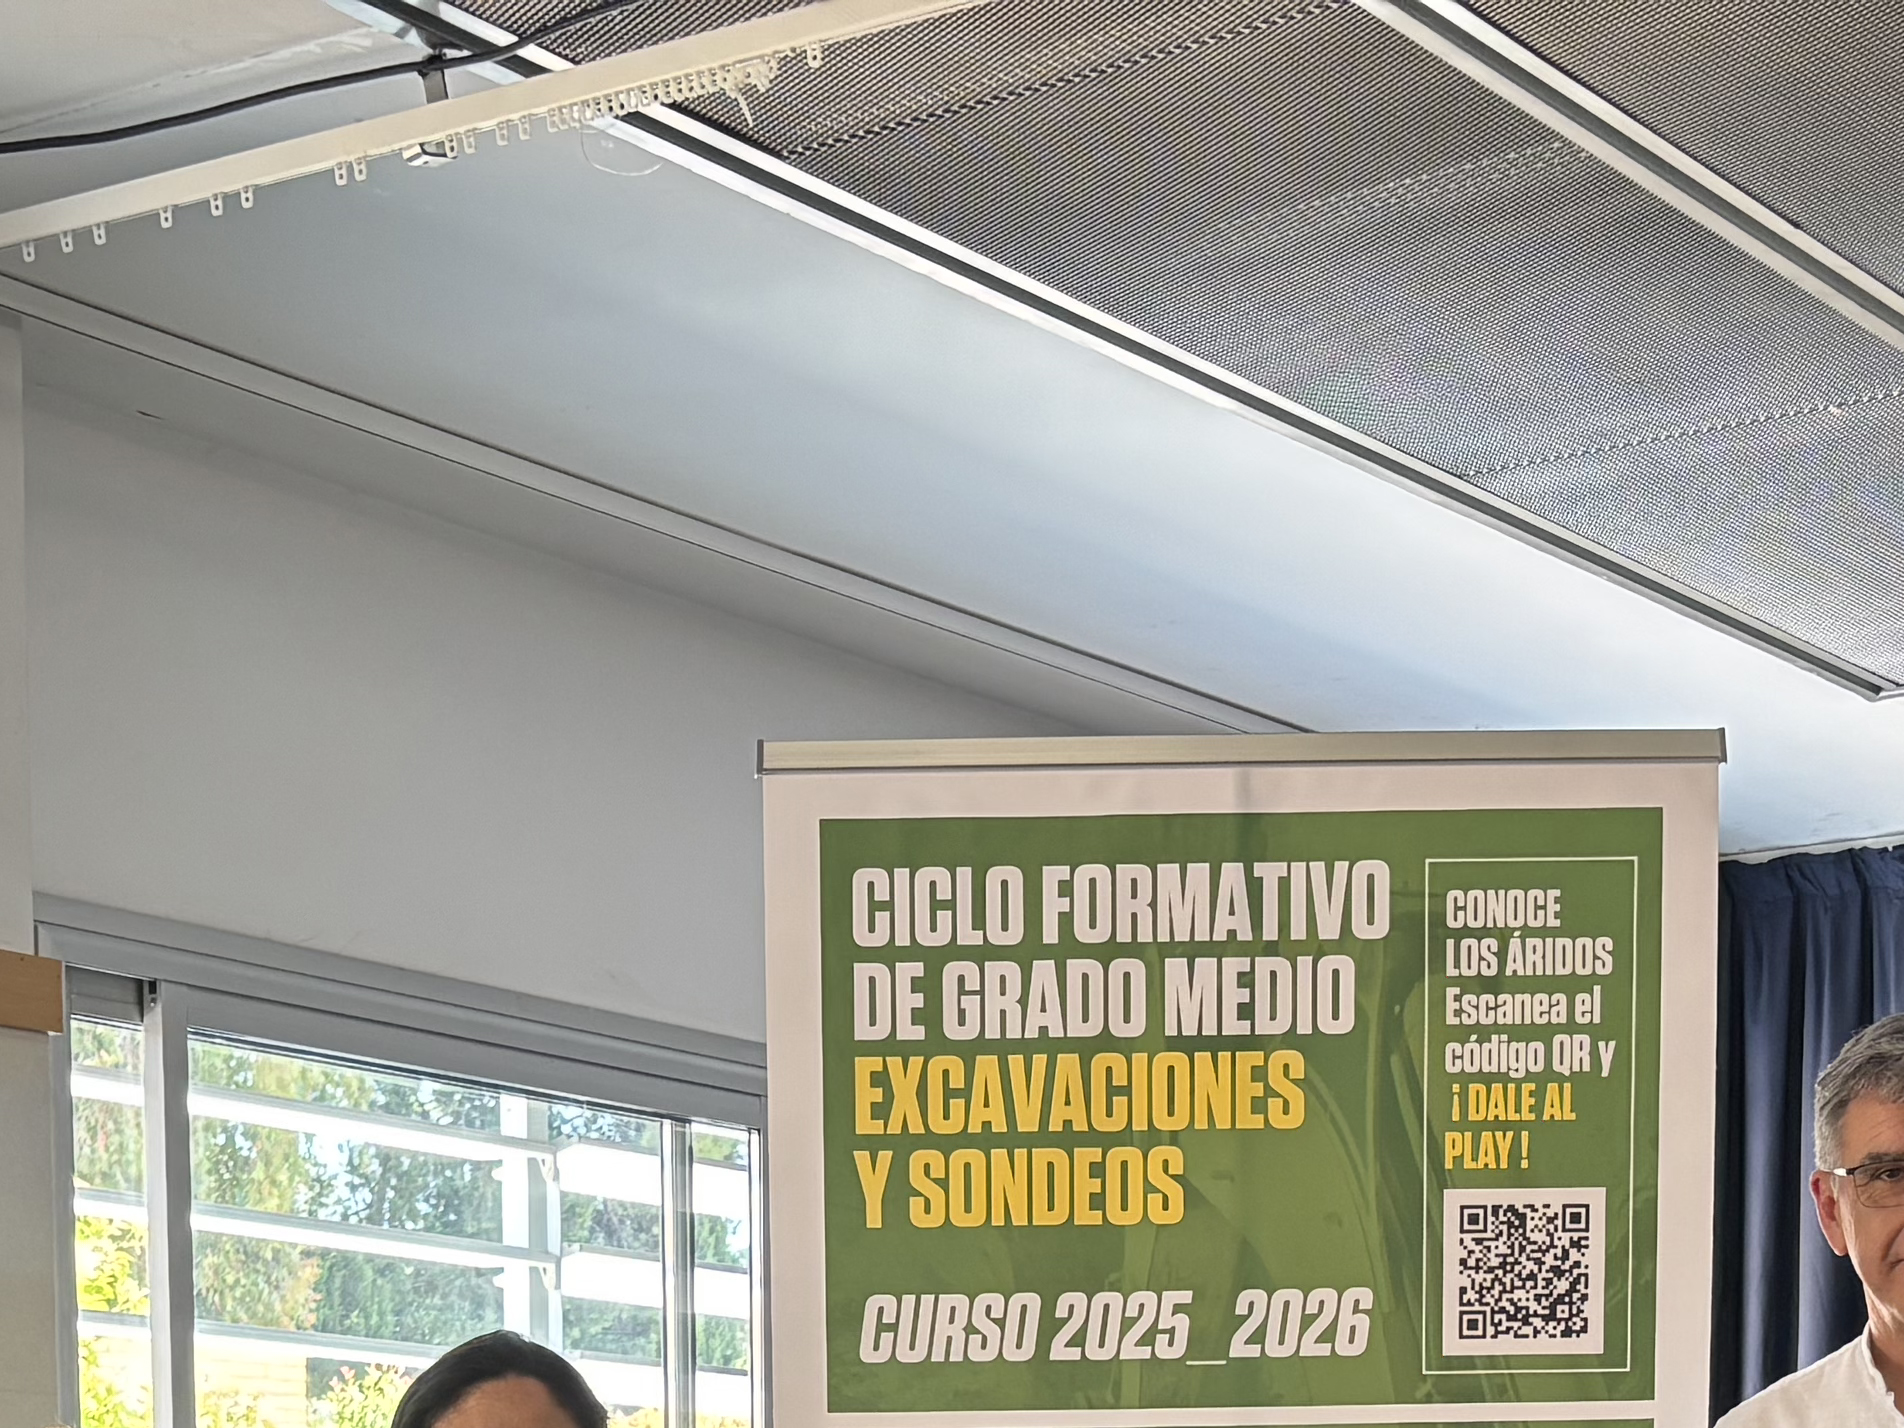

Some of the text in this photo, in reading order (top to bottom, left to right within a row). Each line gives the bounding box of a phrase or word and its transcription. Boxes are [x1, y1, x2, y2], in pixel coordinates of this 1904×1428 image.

[853, 860, 1390, 947] CICLO FORMATIVO
[1447, 889, 1561, 928] CONOCE
[1446, 931, 1613, 976] LOS ÁRIDOS
[854, 955, 1355, 1040] DE GRADO MEDIO
[1446, 985, 1601, 1024] Escanea el
[1445, 1034, 1616, 1078] código QR y
[855, 1050, 1305, 1134] EXCAVACIONES
[1468, 1083, 1535, 1121] DALE
[1543, 1083, 1576, 1120] AL
[1445, 1131, 1513, 1169] PLAY
[853, 1146, 1184, 1228] Y SONDEOS
[860, 1293, 1041, 1363] CURSO
